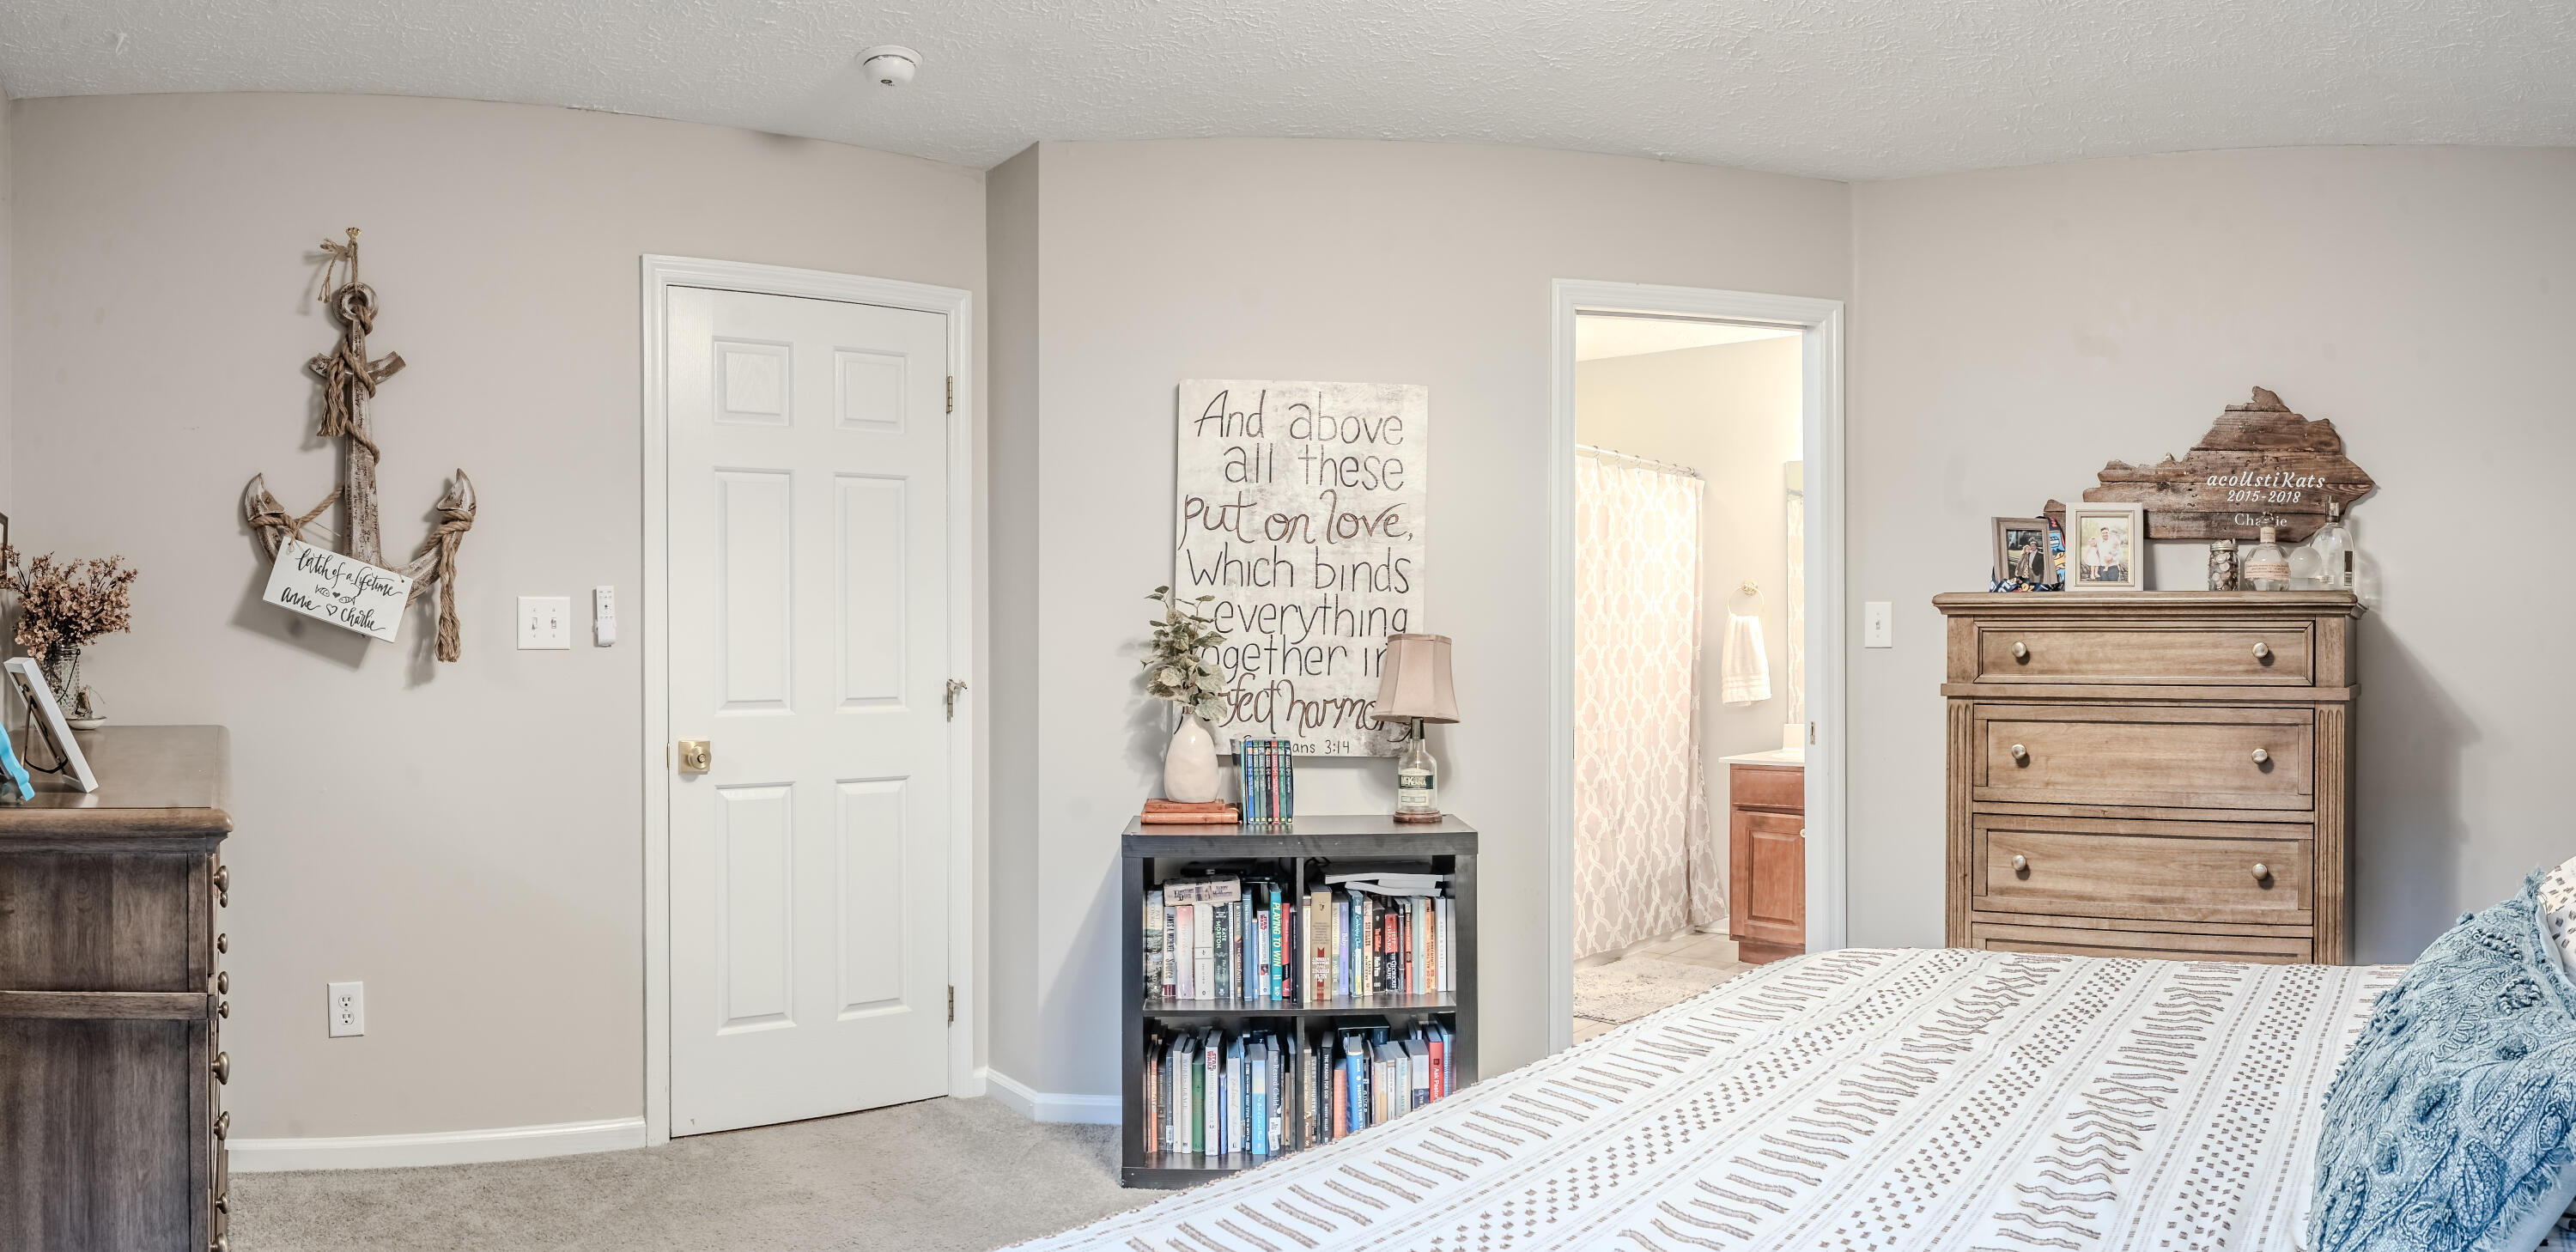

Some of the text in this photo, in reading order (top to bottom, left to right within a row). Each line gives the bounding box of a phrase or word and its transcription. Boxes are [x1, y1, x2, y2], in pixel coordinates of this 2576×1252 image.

[1194, 389, 1404, 446] And above
[1223, 442, 1404, 491] all these
[1264, 513, 1316, 544] on
[1319, 489, 1413, 544] love,
[2227, 489, 2302, 504] 2015-2018
[2234, 513, 2287, 526] Chaie
[331, 562, 347, 589] of
[345, 572, 353, 581] a
[1315, 546, 1412, 594] binds
[1201, 634, 1347, 684] ogether
[1218, 672, 1384, 738] rfect harmo
[1324, 739, 1351, 755] 3:14
[1272, 902, 1281, 967] PLAYING TO WIN
[1164, 958, 1175, 979] Source
